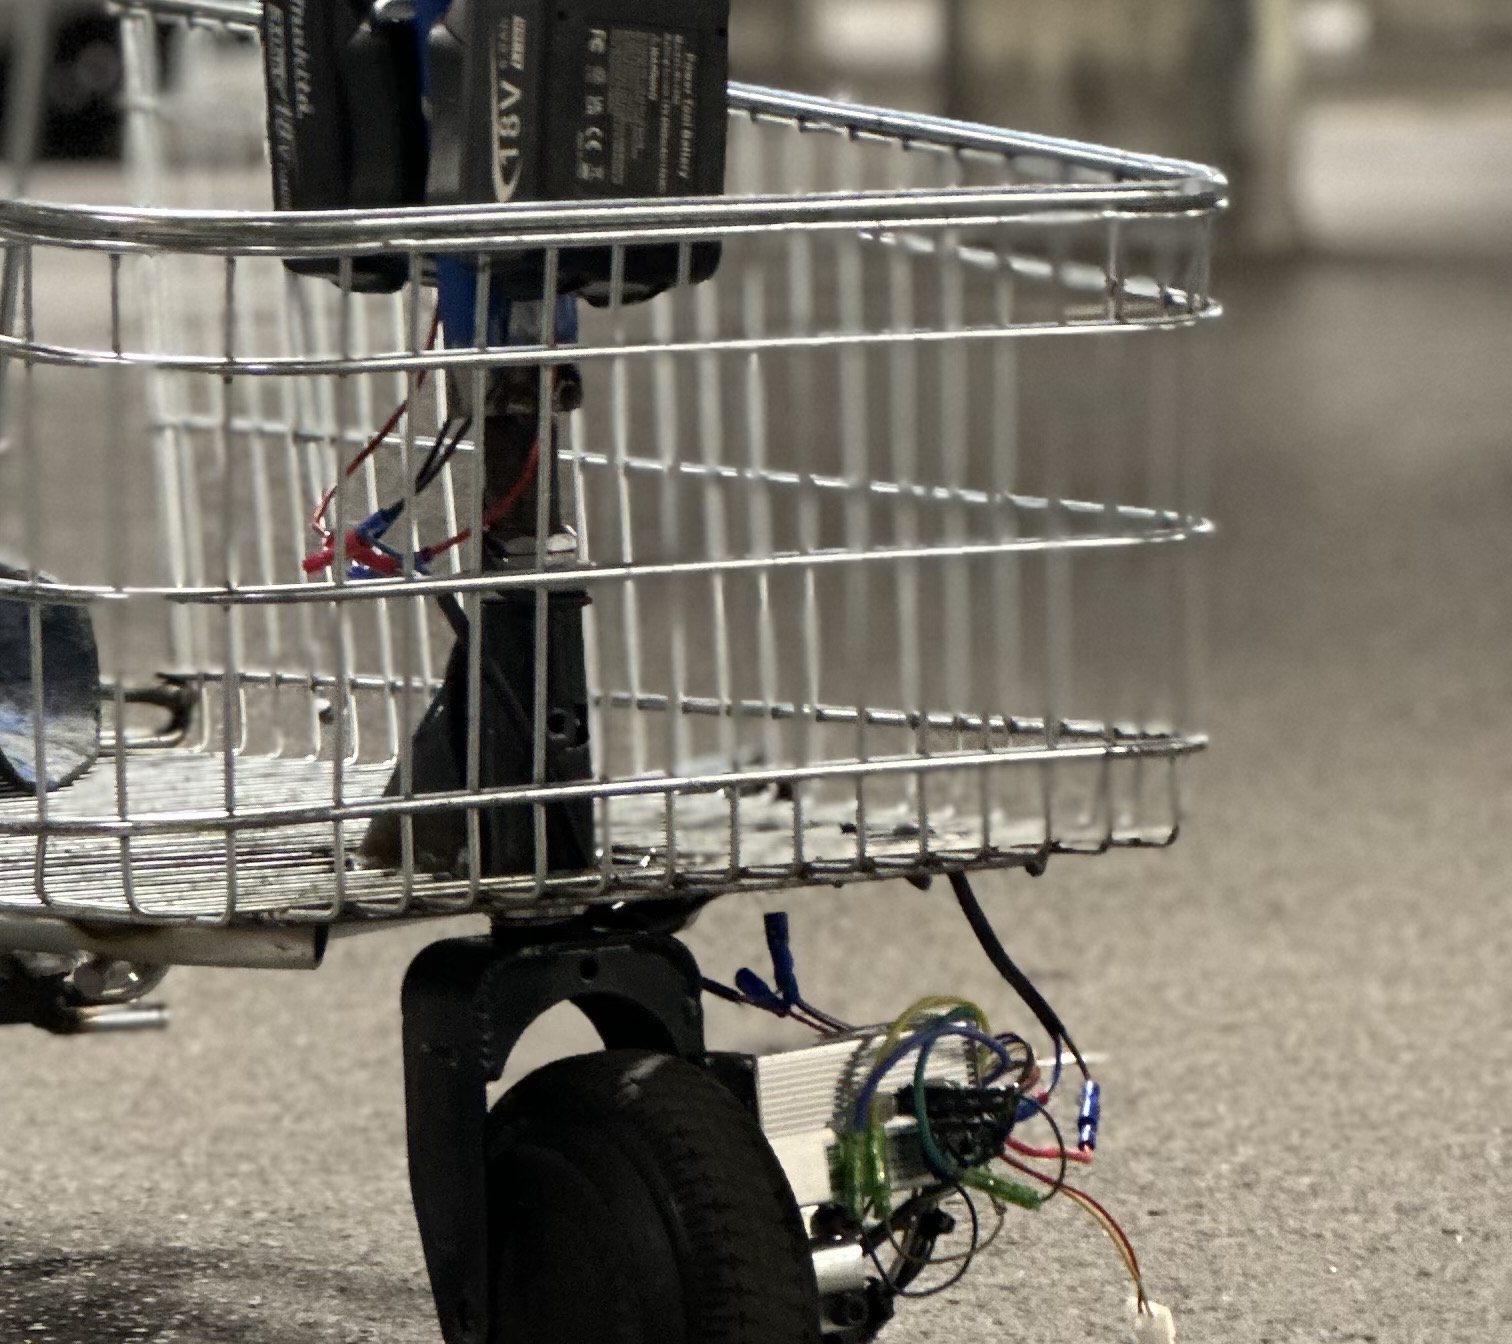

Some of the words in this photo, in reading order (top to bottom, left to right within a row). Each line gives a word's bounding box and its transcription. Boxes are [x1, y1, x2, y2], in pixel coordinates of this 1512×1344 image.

[498, 81, 522, 167] 18V
[681, 98, 694, 125] Tool
[678, 129, 693, 179] Battery
